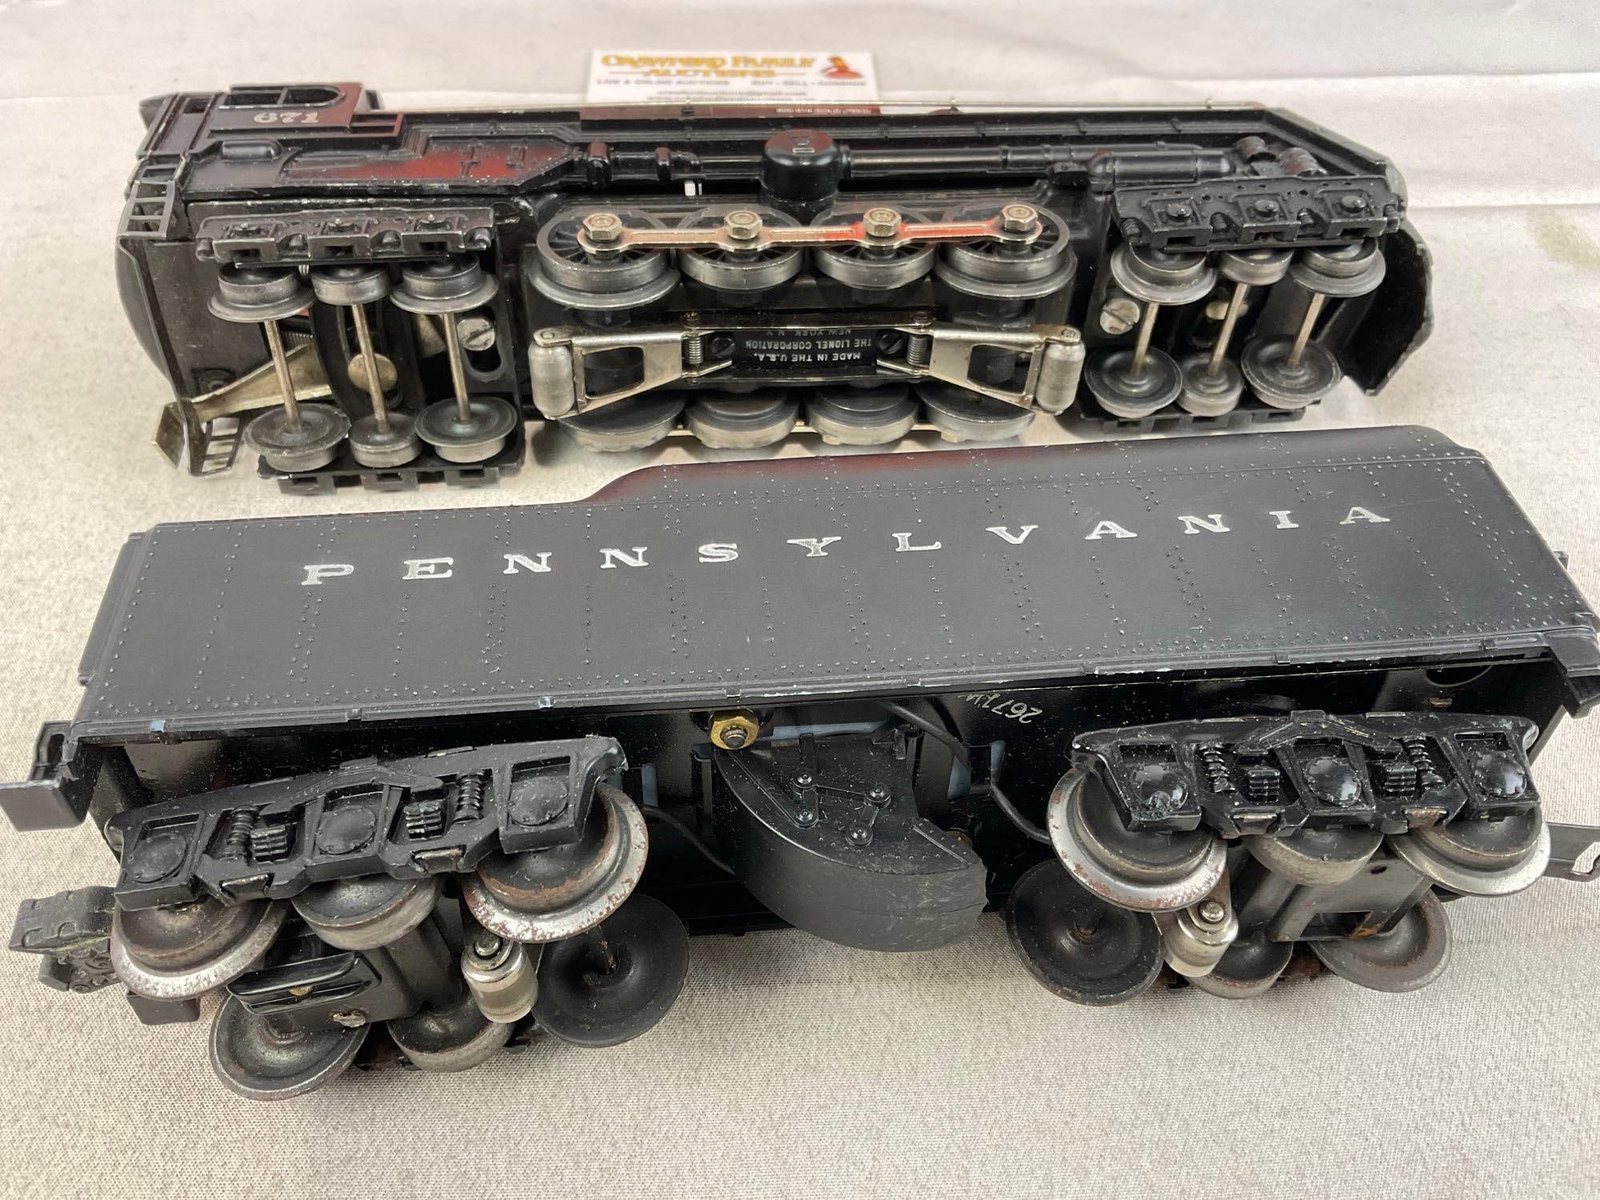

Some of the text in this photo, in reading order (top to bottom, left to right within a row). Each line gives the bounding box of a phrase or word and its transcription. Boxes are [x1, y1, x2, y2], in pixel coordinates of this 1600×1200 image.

[253, 111, 319, 124] 671
[794, 329, 824, 337] YORK
[745, 338, 872, 350] THE LIONEL CORPORATION
[753, 352, 861, 362] MADE IN THE U.S.A.
[301, 506, 1391, 585] PENNSYLVANIA
